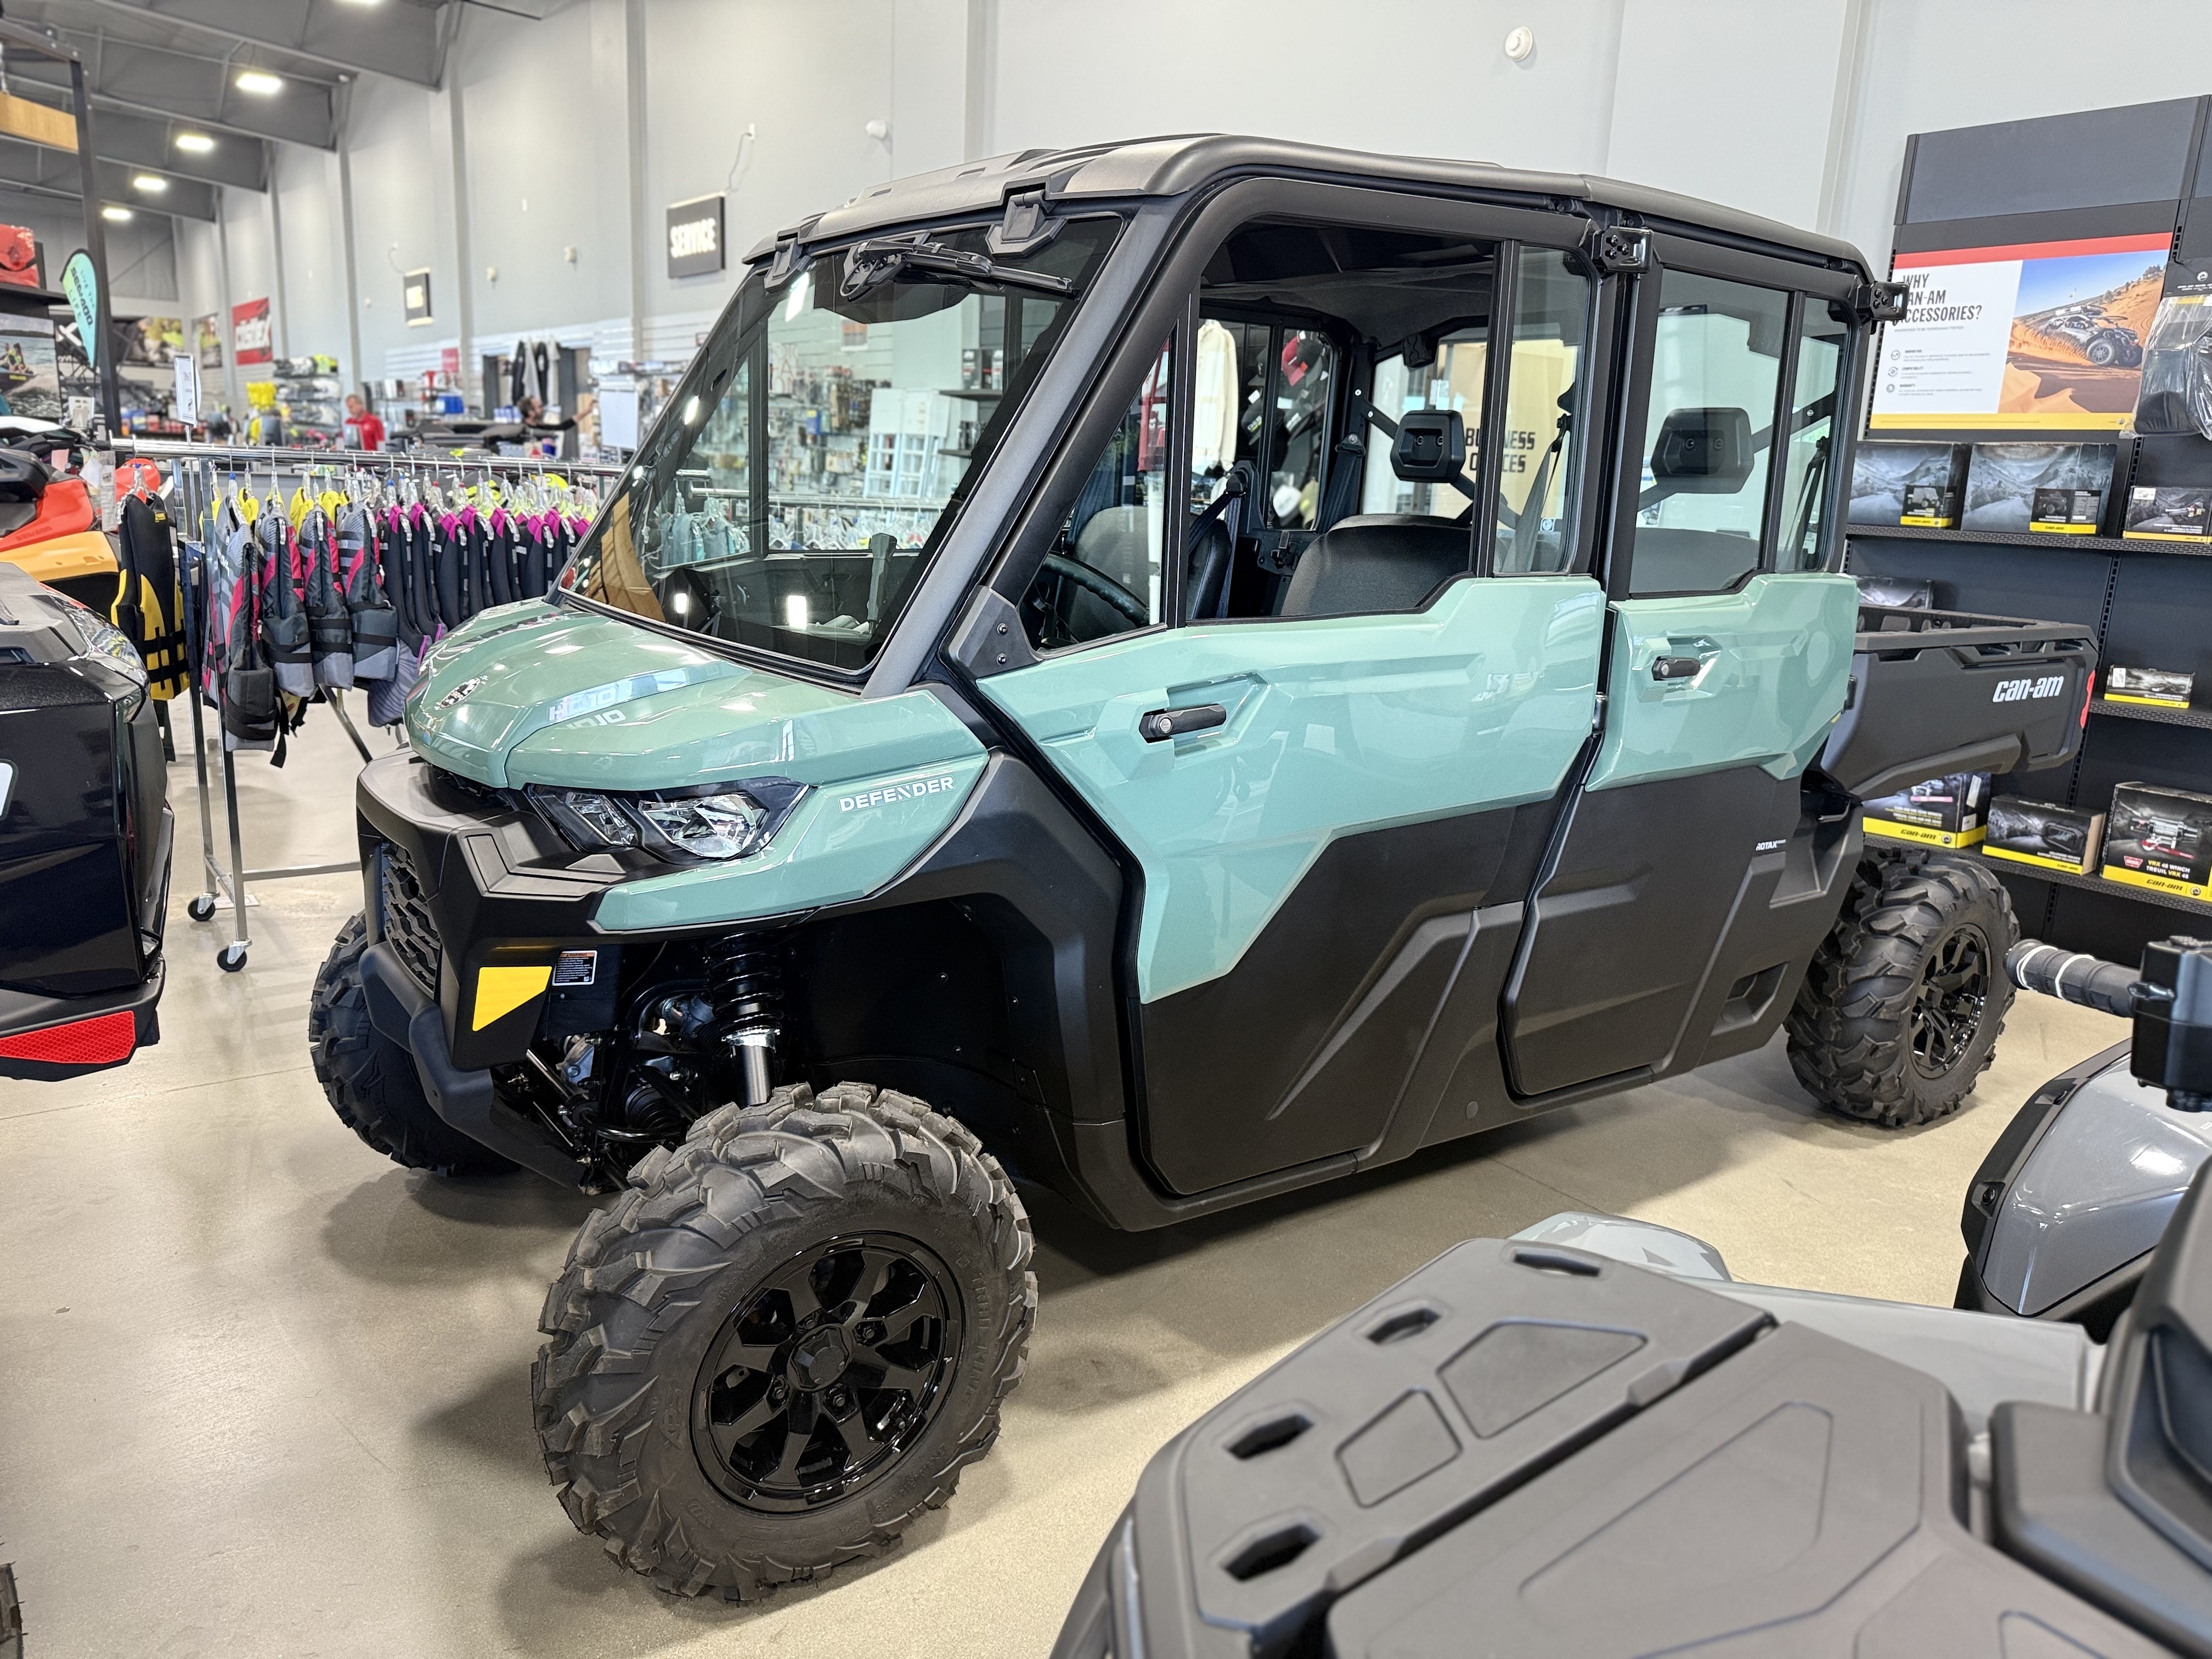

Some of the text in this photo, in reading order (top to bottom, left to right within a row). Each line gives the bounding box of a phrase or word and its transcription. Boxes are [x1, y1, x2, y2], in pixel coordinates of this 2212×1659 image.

[1903, 274, 1929, 288] WHY
[1908, 290, 1946, 306] AN-AM
[1900, 305, 1982, 324] CCESSORIES?
[1993, 675, 2064, 703] can-am
[839, 776, 955, 812] DEFENDER
[1901, 829, 1937, 840] can-am
[1756, 840, 1778, 851] ROTAX
[2146, 865, 2167, 875] TREUIL
[2169, 864, 2191, 873] WINCH
[2146, 879, 2183, 891] can-am
